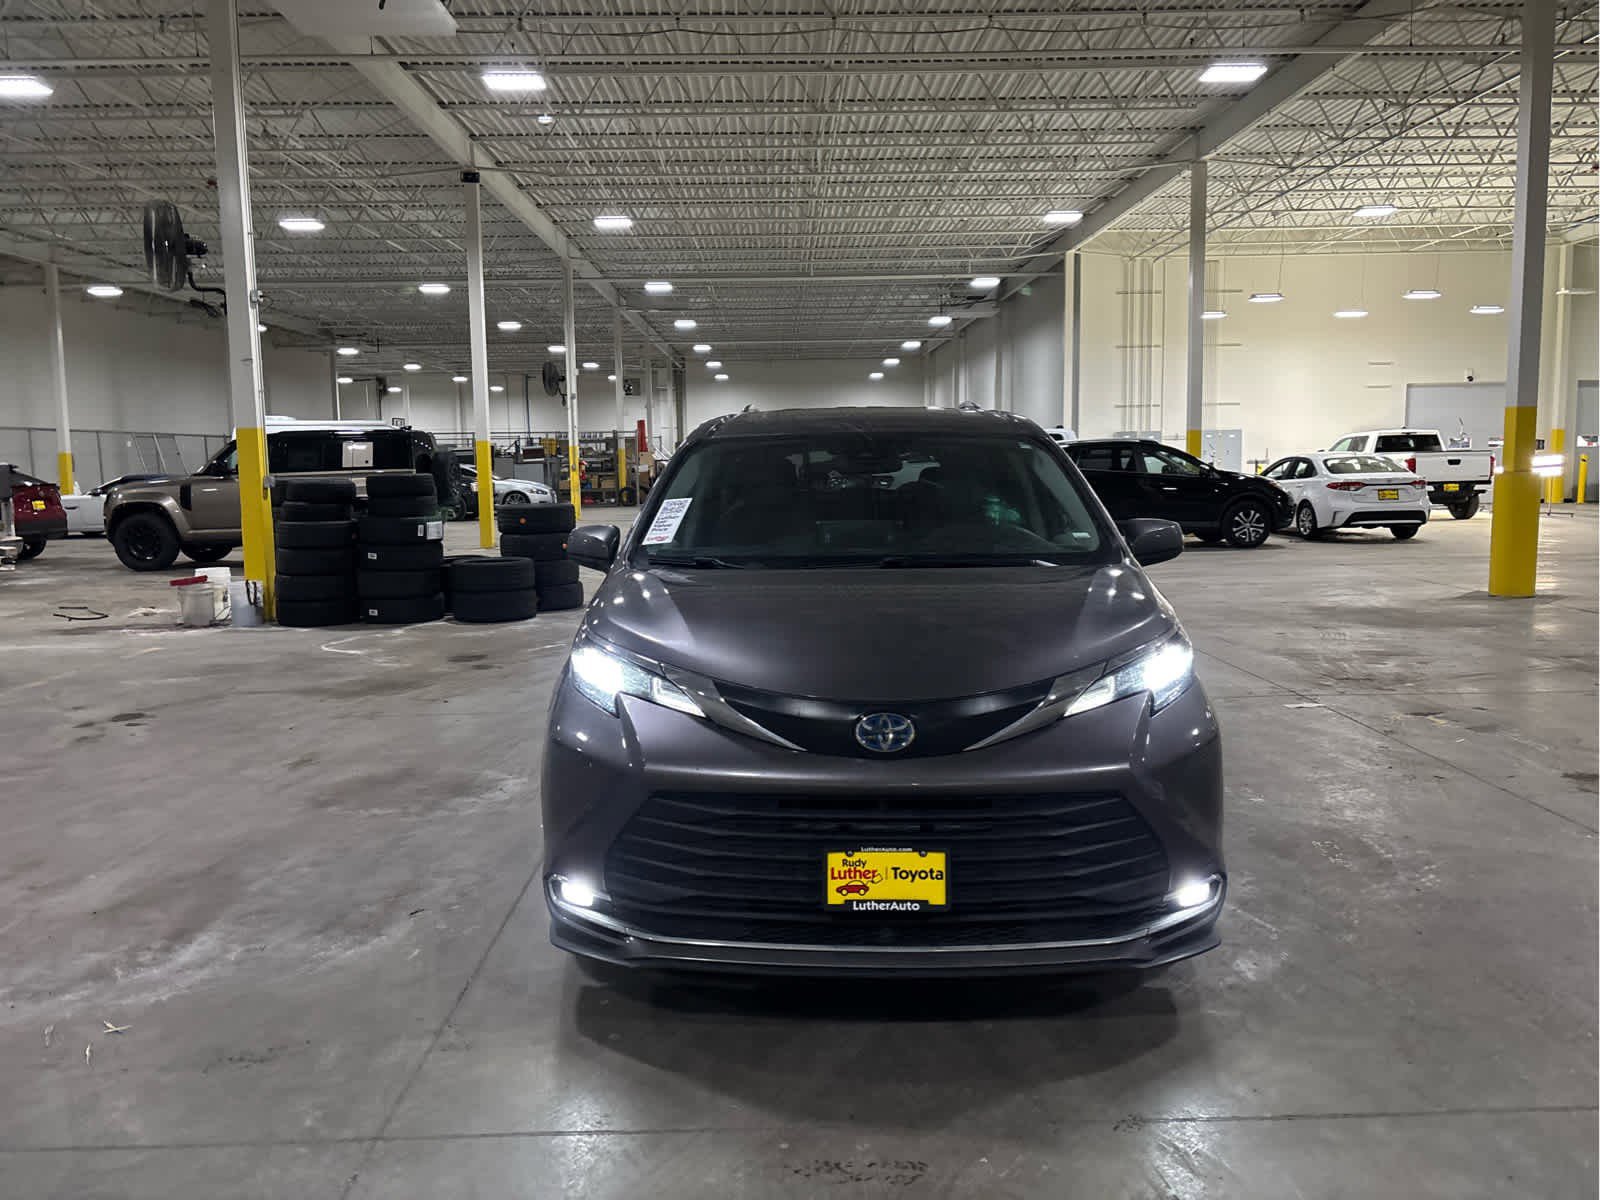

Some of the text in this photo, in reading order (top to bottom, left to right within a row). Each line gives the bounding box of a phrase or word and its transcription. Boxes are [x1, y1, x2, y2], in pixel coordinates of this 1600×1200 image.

[841, 858, 867, 868] Rudy
[830, 867, 944, 882] Luther Toyota
[852, 901, 920, 911] LutherAuto
